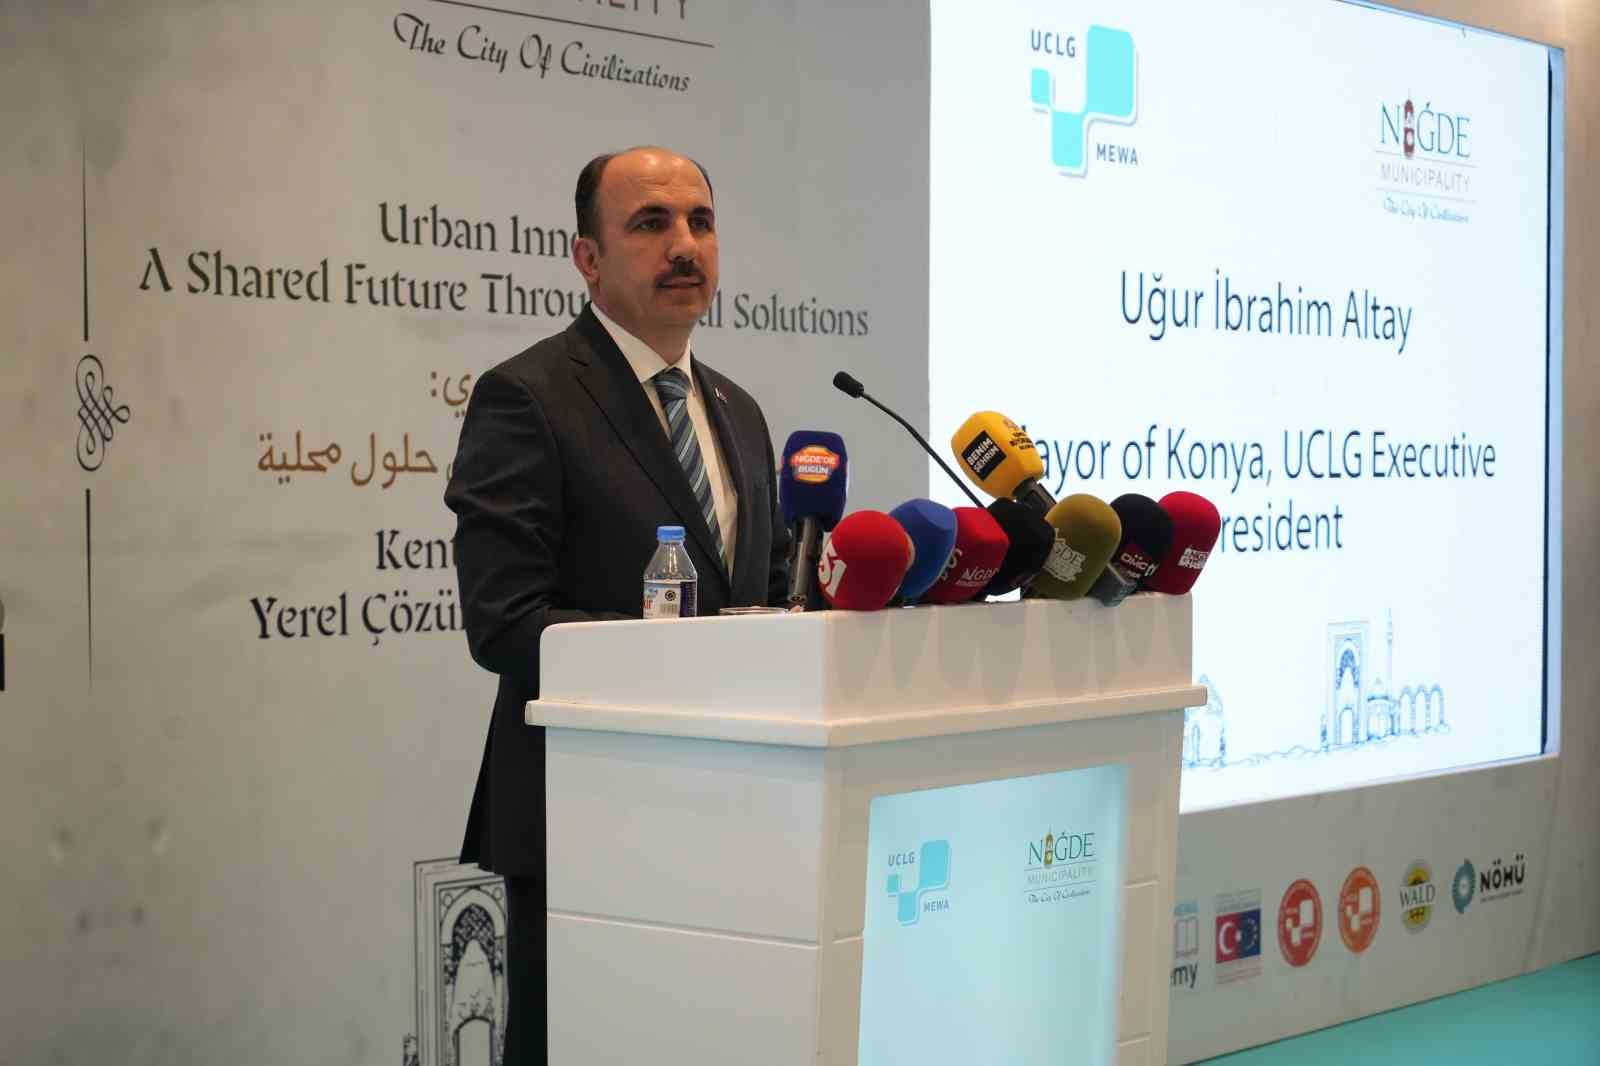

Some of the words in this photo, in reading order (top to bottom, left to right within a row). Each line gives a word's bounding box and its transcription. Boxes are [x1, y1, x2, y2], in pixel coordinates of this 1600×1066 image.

[393, 13, 445, 55] The
[457, 25, 507, 72] City
[520, 34, 551, 78] Of
[561, 41, 690, 91] Civilizations
[1031, 29, 1076, 58] UCLG
[1096, 143, 1138, 166] MEWA
[379, 202, 498, 252] Urban
[139, 248, 172, 292] A
[187, 250, 330, 303] Shared
[344, 264, 467, 311] Future
[480, 272, 586, 317] Throu
[734, 293, 869, 336] Solutions
[1122, 270, 1204, 341] Uğur
[1214, 268, 1332, 337] İbrahim
[1342, 289, 1411, 355] Altay
[258, 430, 341, 484] محلية
[351, 432, 438, 489] حلول
[1026, 430, 1111, 495] ayor
[1123, 424, 1157, 480] of
[1167, 427, 1272, 494] Konya,
[1284, 429, 1361, 479] UCLG
[1373, 431, 1495, 478] Executive
[1221, 500, 1343, 552] resident
[250, 592, 349, 639] Yerel
[361, 589, 465, 646] Çözü
[888, 851, 915, 867] UCLG
[1480, 854, 1525, 892] NÖHÜ
[1400, 883, 1436, 907] WALD
